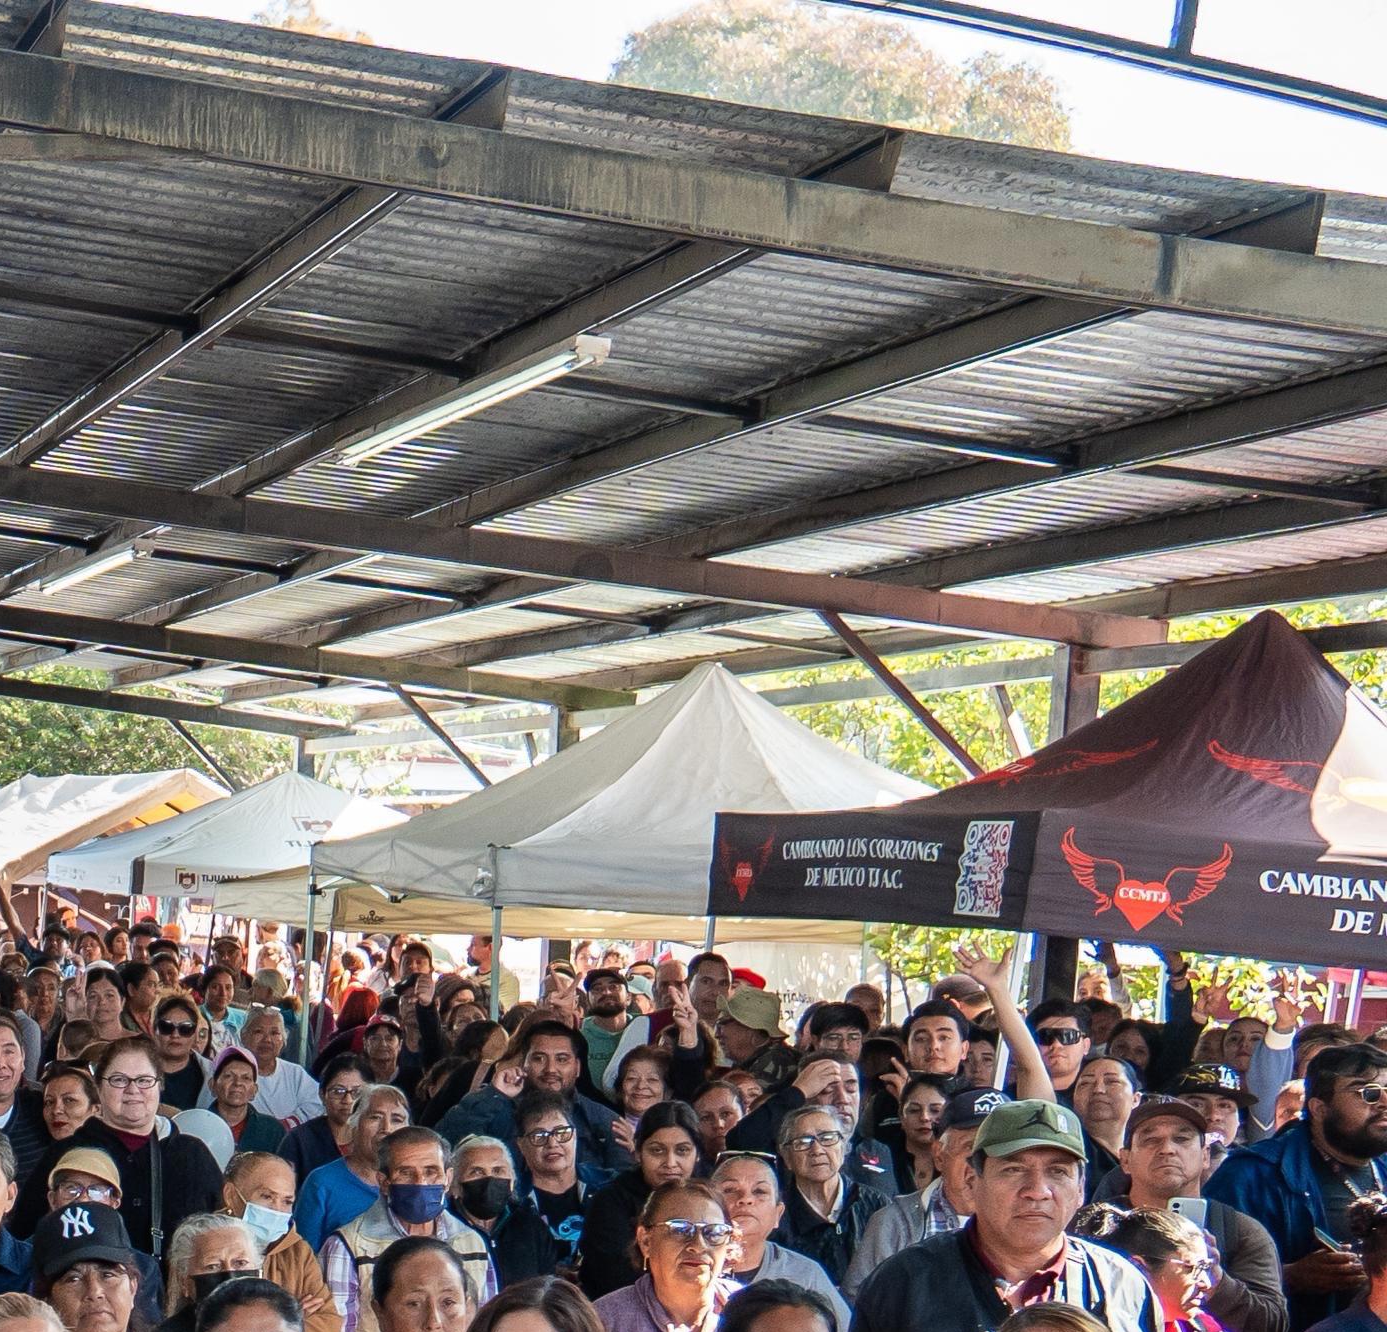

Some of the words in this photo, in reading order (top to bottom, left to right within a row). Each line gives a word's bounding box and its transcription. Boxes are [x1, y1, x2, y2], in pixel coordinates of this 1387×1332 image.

[783, 839, 844, 860] CAMBIANDO
[846, 838, 867, 858] LOS
[870, 838, 943, 862] CORAZONES
[804, 868, 821, 887] DE
[822, 862, 865, 887] MÉXICO
[868, 868, 880, 888] TJ
[881, 869, 903, 889] A.C.
[1118, 887, 1168, 903] CCMTJ
[1330, 909, 1374, 935] DE
[60, 1207, 95, 1238] NY
